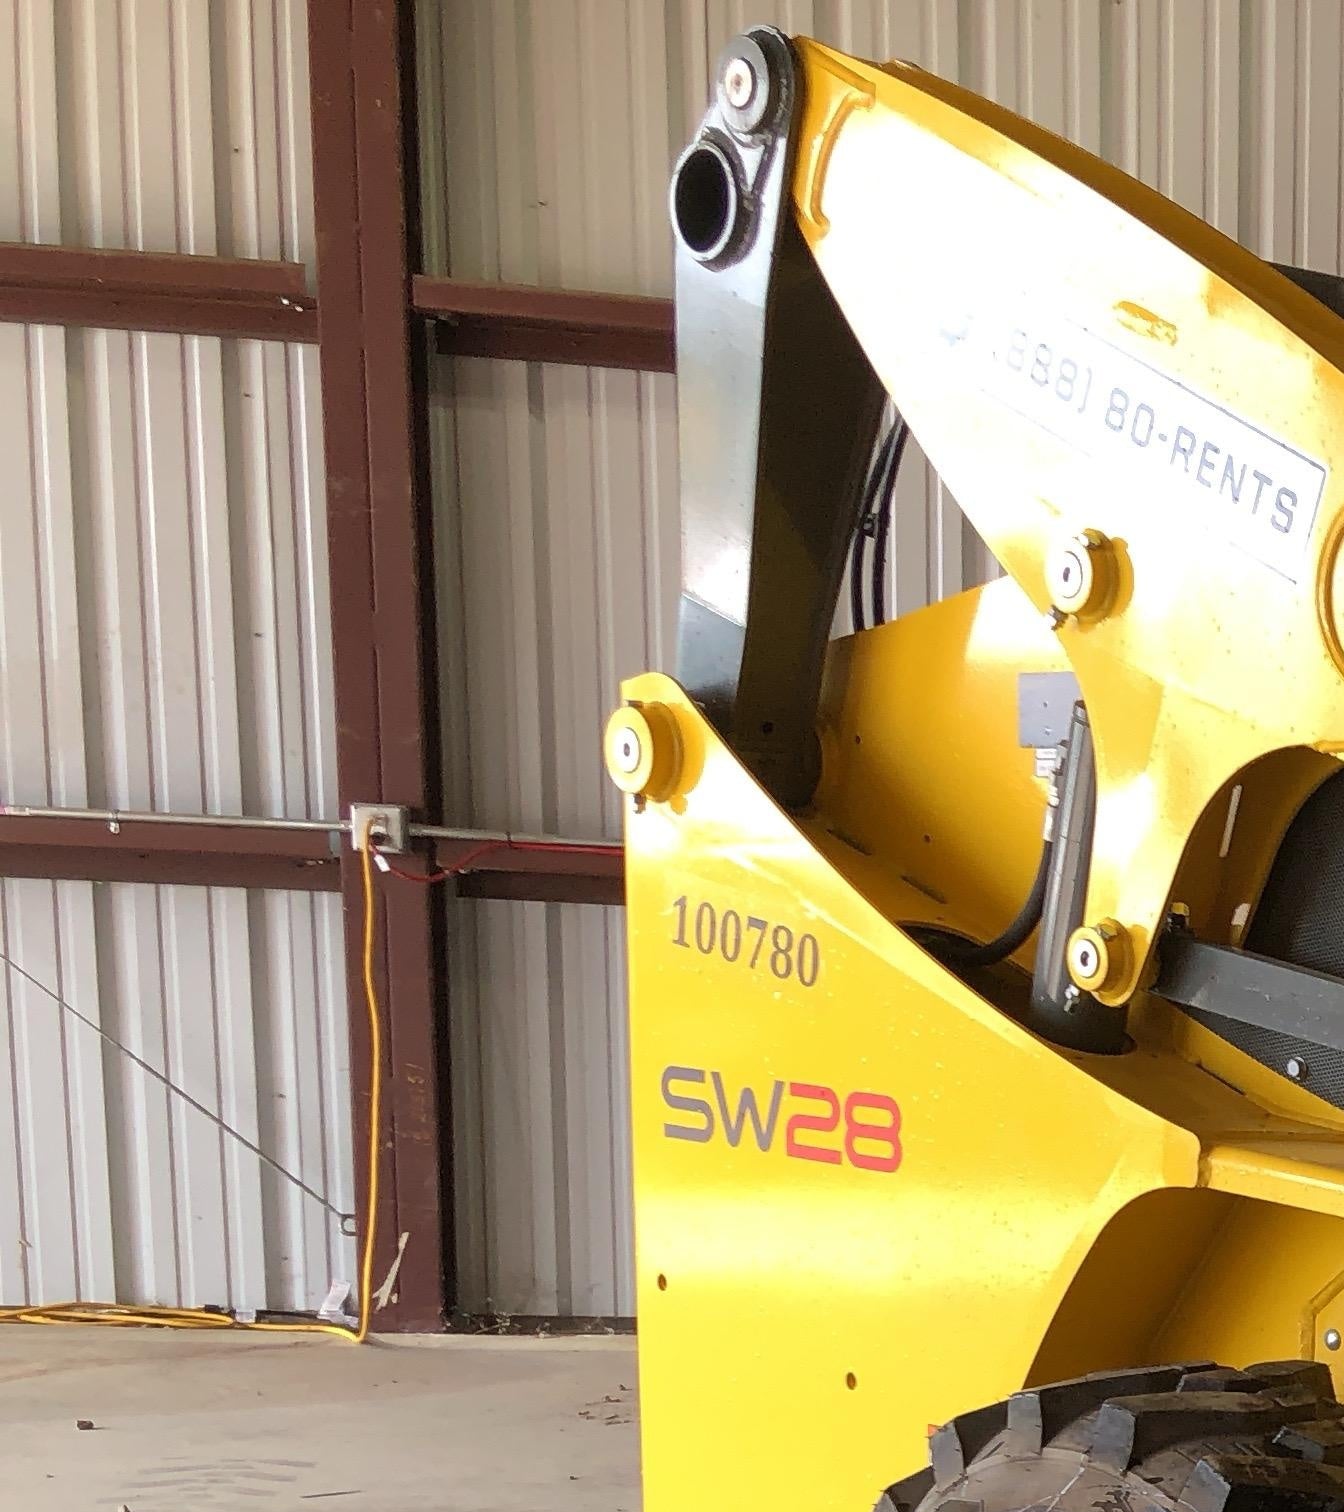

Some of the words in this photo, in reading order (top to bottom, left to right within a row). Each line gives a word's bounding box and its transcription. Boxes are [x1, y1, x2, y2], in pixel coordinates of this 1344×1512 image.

[1103, 388, 1298, 535] 80-RENTS
[671, 894, 821, 988] 100780
[660, 1065, 904, 1174] SW28
